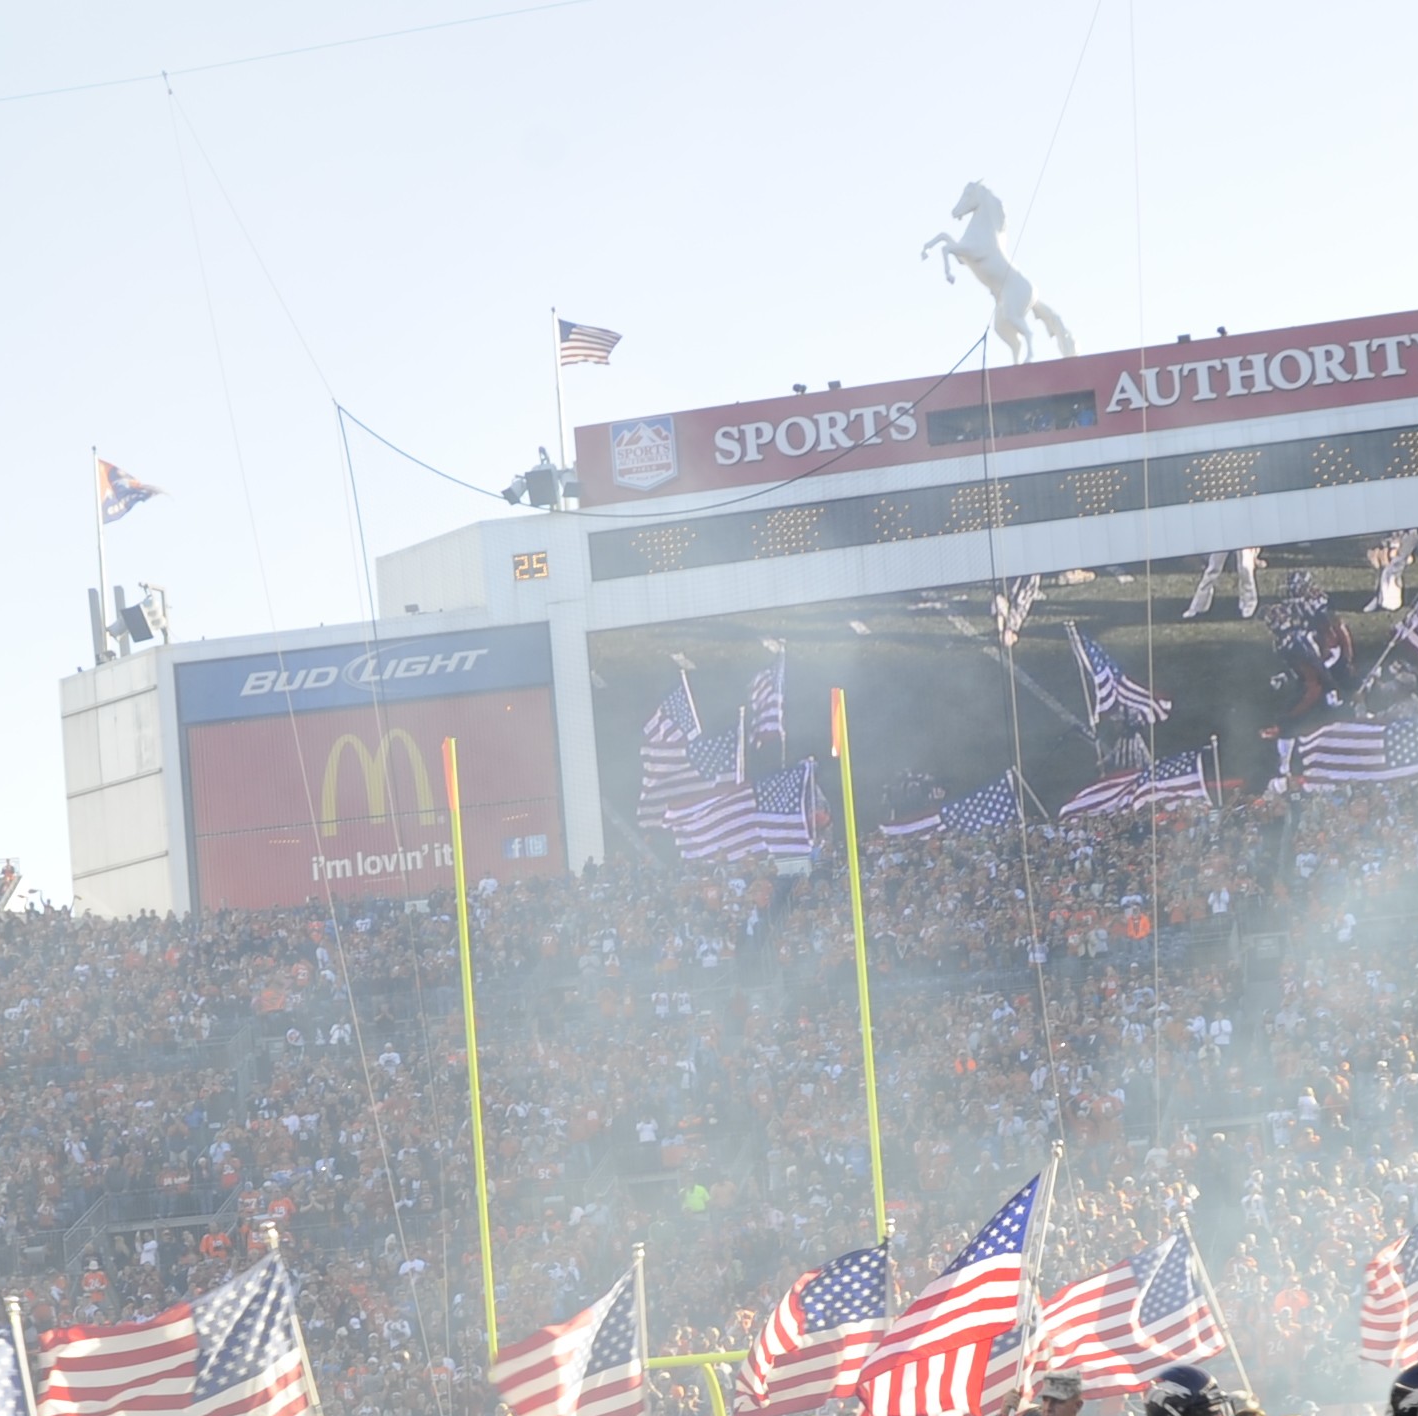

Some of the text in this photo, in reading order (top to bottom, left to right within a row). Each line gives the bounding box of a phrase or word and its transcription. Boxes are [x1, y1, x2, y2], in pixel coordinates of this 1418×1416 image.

[617, 442, 671, 460] SPORTS
[715, 401, 919, 466] SPORTS
[514, 552, 549, 581] 25
[240, 647, 489, 697] BUD LIGHT
[311, 840, 456, 881] i'm lovin' it
